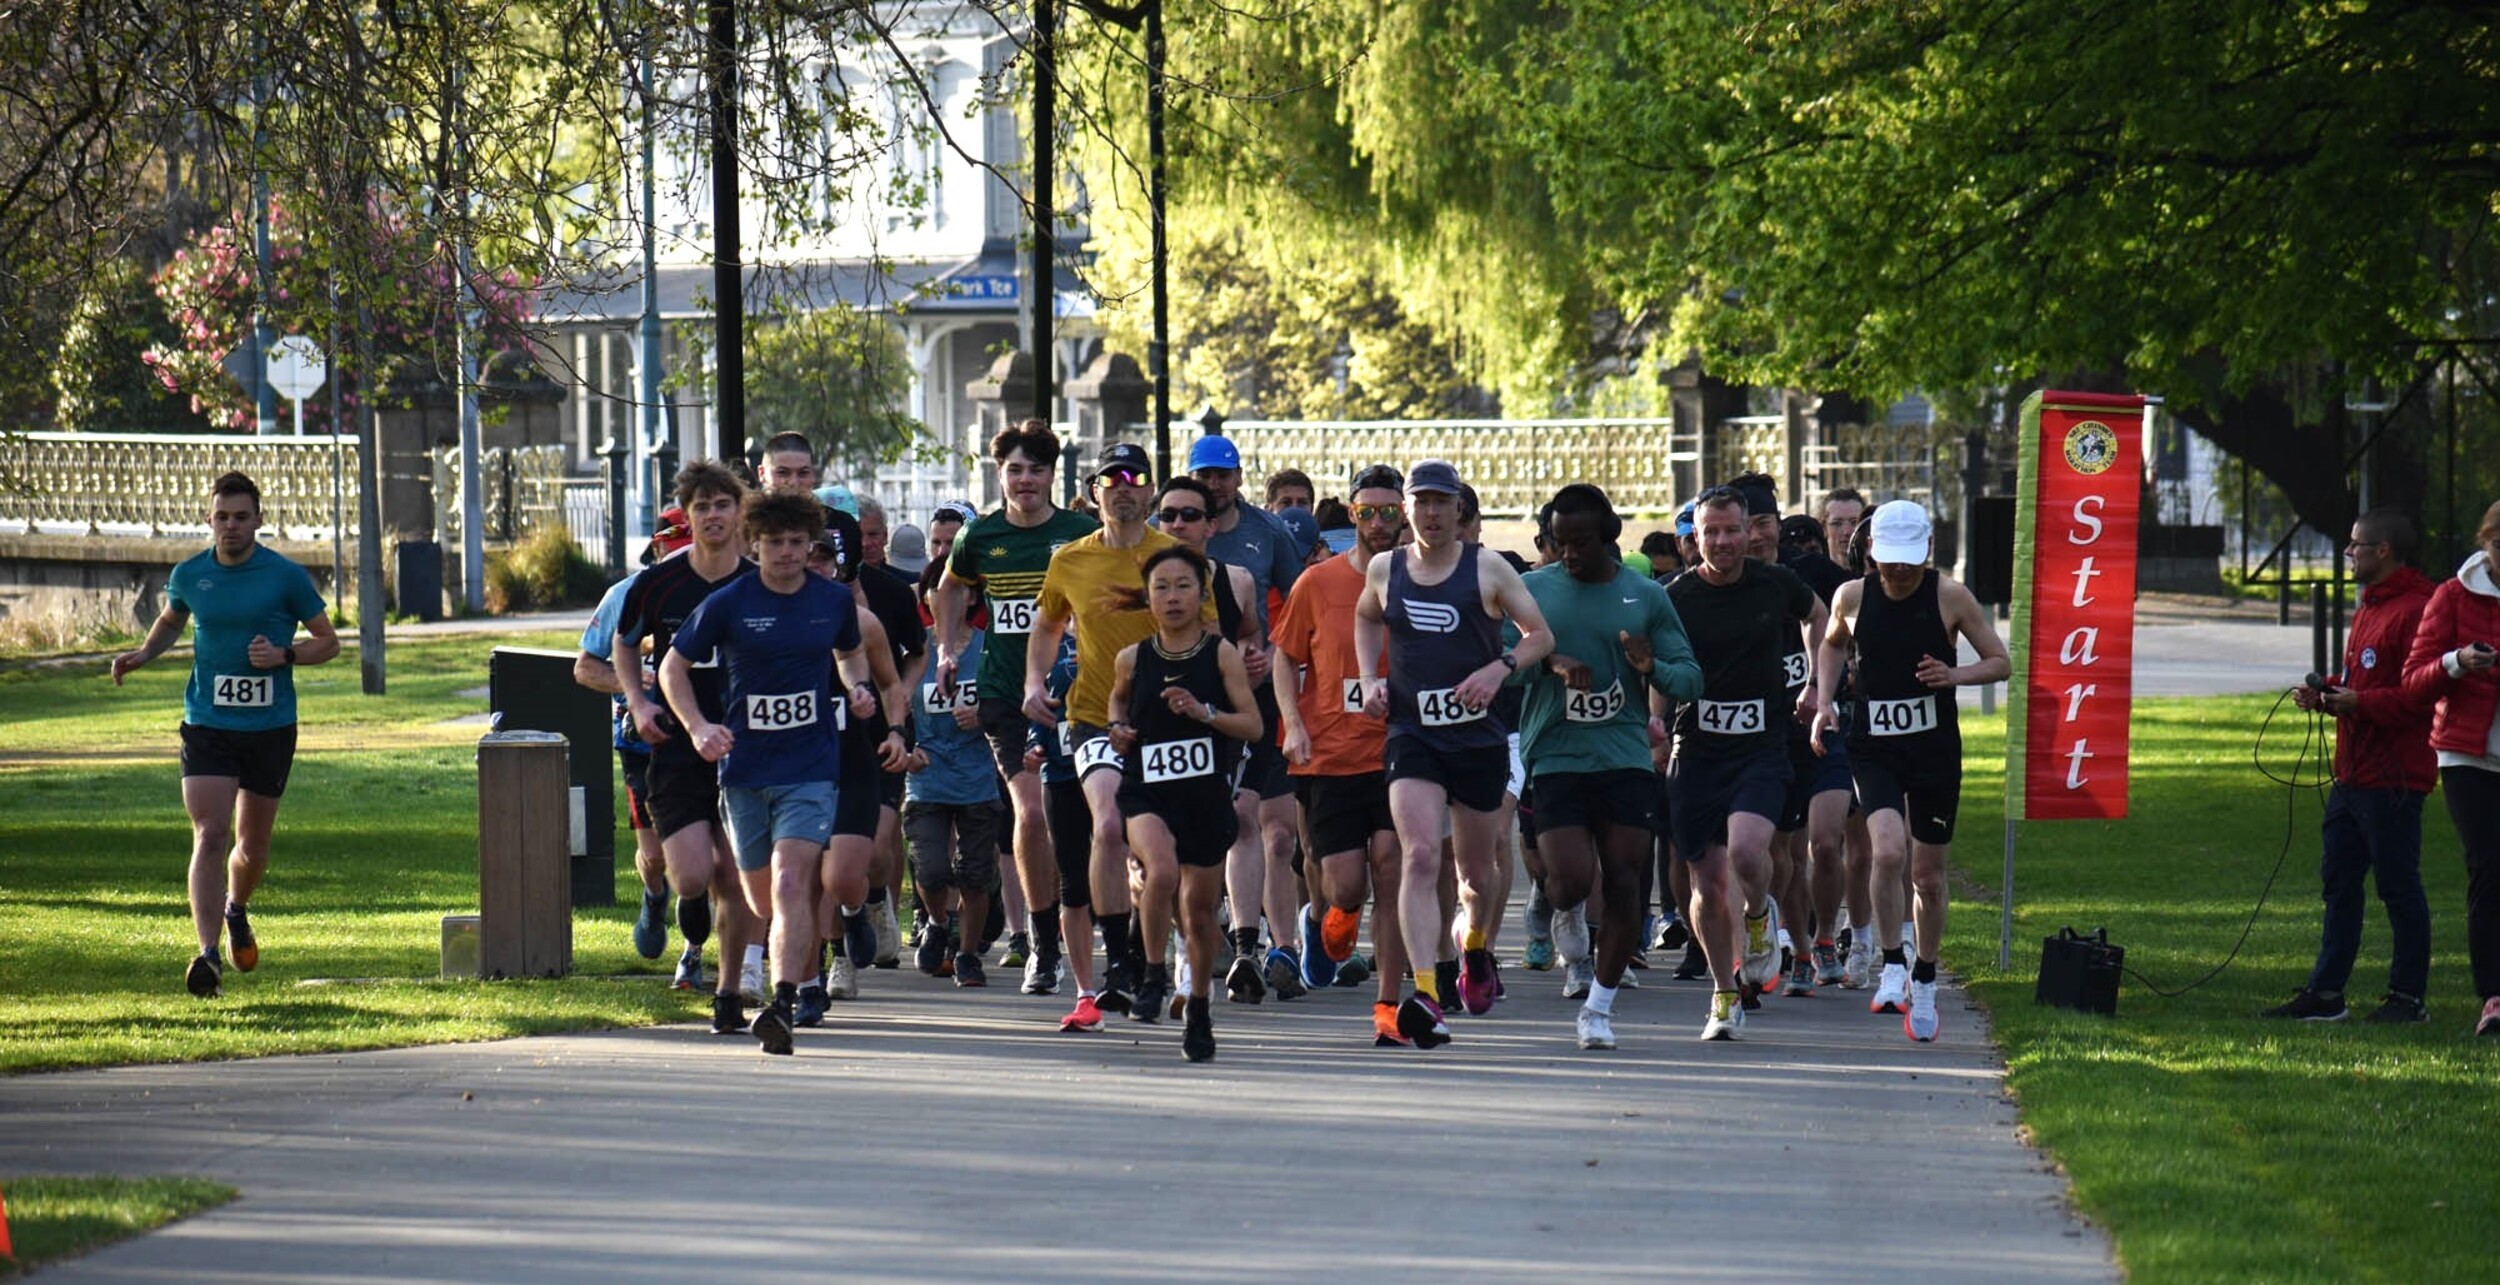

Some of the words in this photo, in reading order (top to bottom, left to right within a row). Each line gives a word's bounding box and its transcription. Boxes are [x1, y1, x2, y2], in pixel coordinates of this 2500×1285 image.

[989, 279, 1013, 297] Tce
[997, 602, 1038, 630] 46
[2059, 494, 2105, 790] Start
[217, 678, 267, 703] 481
[1569, 684, 1622, 719] 495
[751, 694, 812, 726] 488
[1703, 703, 1760, 730] 473
[1873, 699, 1928, 731] 401
[1147, 741, 1210, 776] 480
